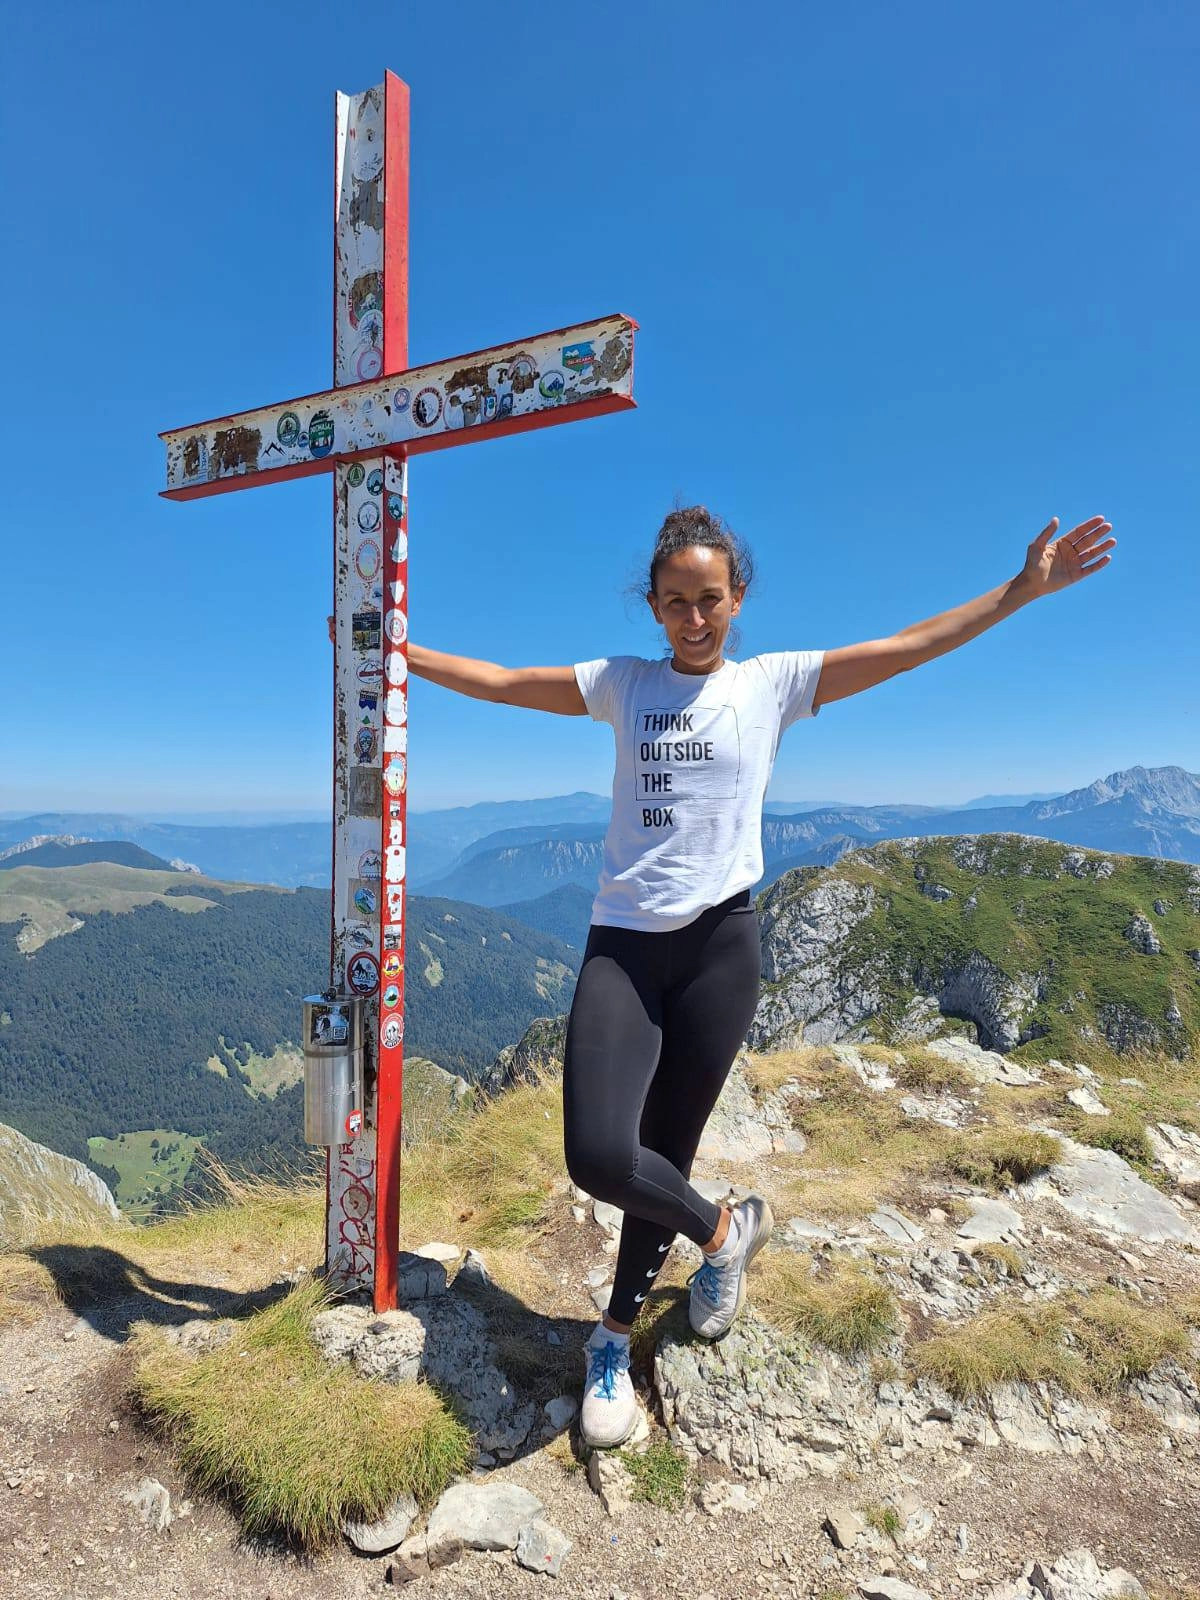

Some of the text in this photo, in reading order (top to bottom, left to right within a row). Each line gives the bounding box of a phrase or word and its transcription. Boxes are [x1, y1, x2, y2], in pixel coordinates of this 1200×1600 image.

[643, 713, 694, 732] THINK
[640, 742, 714, 762] OUTSIDE
[642, 773, 673, 793] THE
[642, 808, 674, 828] BOX
